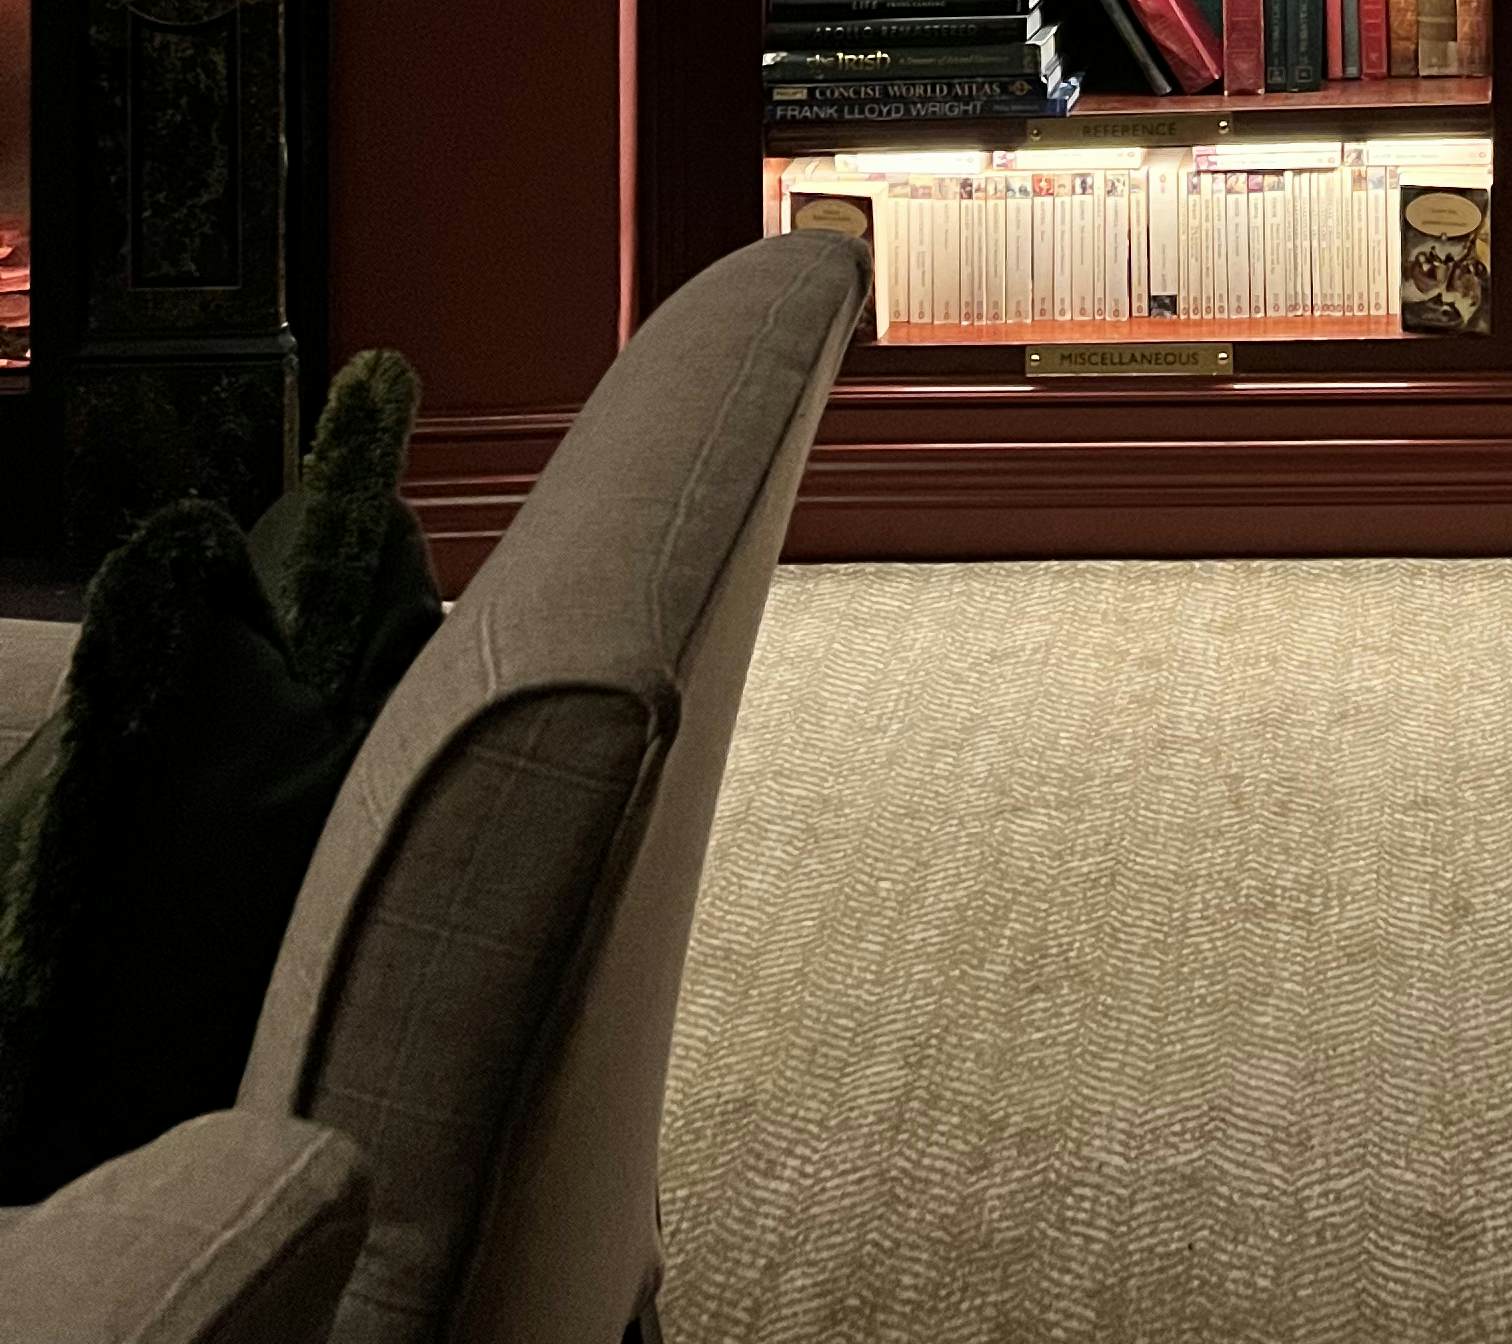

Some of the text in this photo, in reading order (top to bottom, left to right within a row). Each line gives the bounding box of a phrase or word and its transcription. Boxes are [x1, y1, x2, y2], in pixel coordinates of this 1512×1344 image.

[814, 24, 976, 40] APOLLO REMASTERED
[815, 86, 883, 100] CONCISE
[887, 84, 948, 99] WORLD
[952, 83, 1001, 97] ATLAS
[776, 100, 984, 120] FRANK LLOYD WRIGHT
[1082, 122, 1177, 137] REFERENCE
[1060, 352, 1199, 366] MISCELLANEOUS
